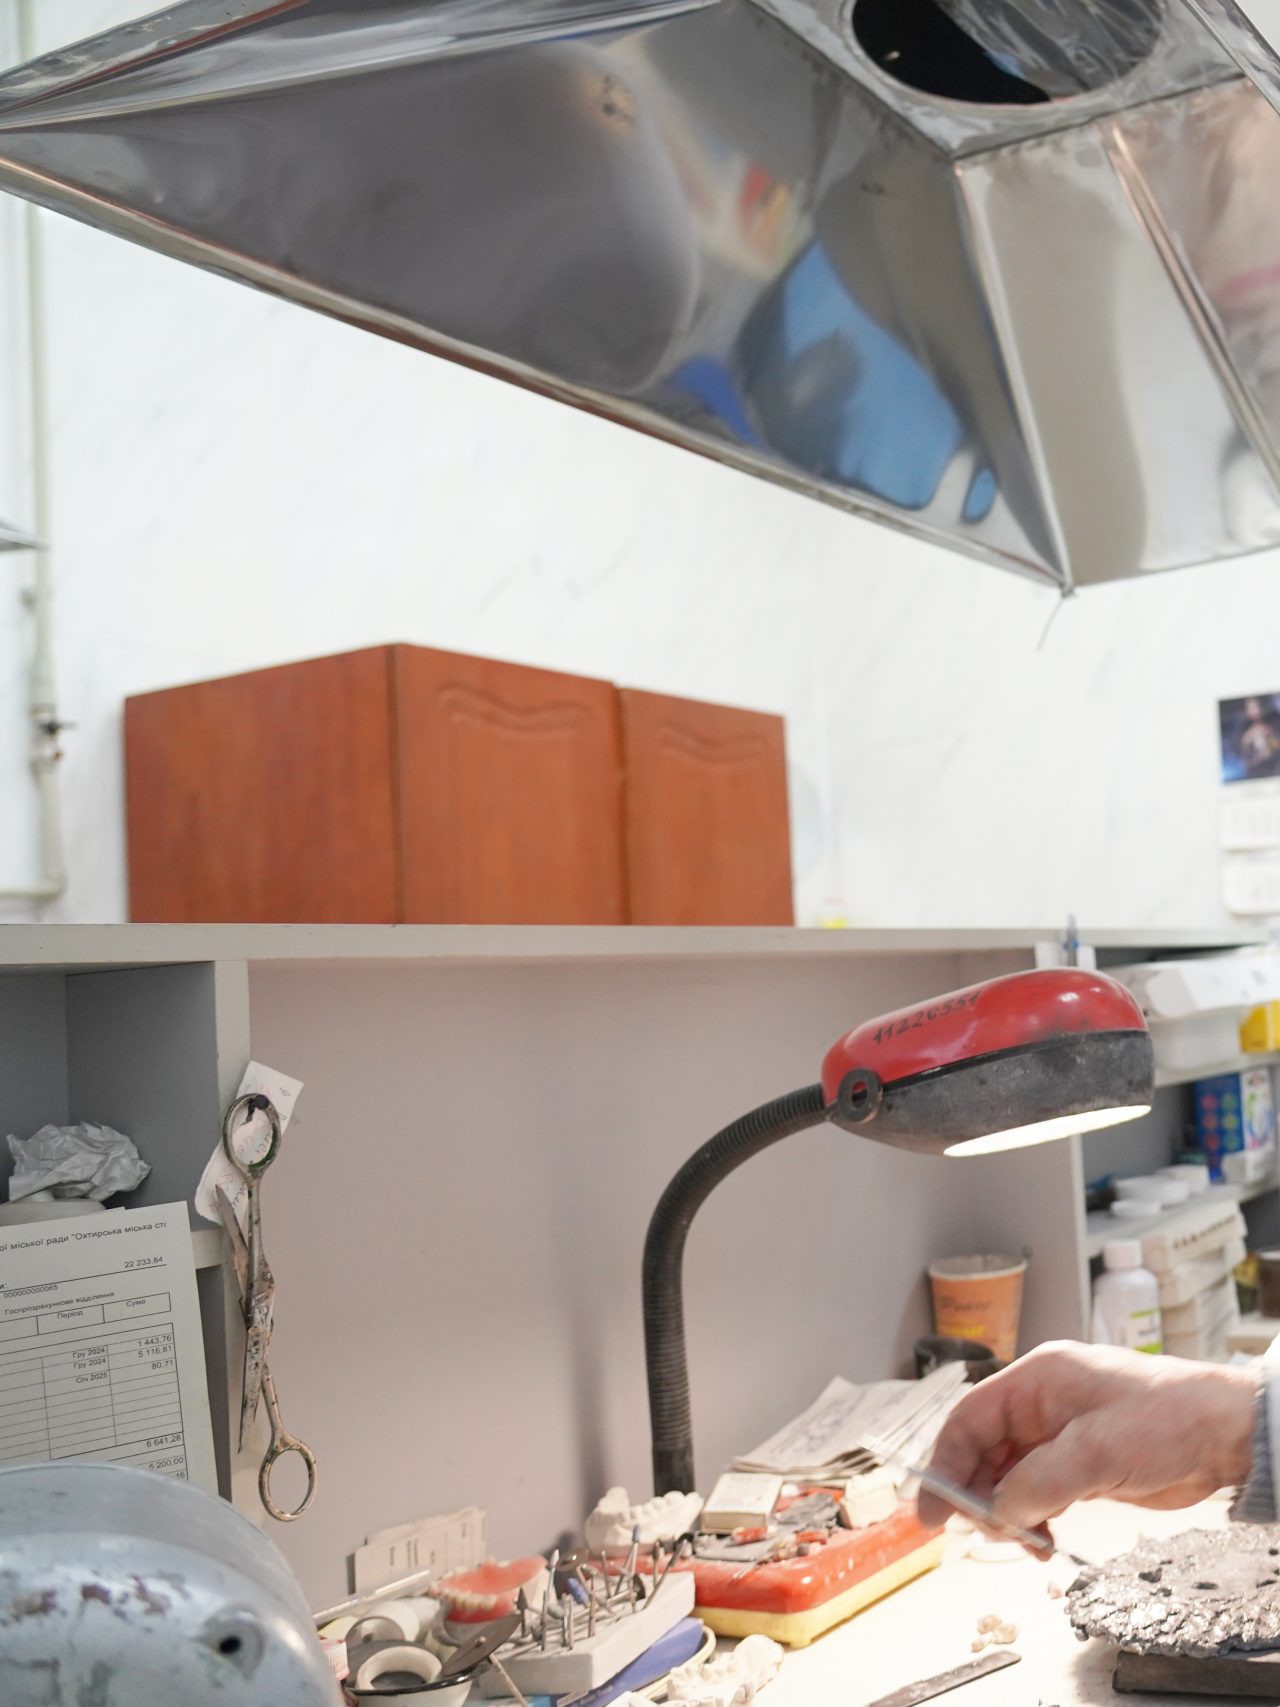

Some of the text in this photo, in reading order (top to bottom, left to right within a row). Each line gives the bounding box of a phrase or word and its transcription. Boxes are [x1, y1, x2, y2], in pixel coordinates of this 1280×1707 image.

[10, 1240, 44, 1250] міської
[46, 1236, 69, 1246] ради
[124, 1223, 153, 1233] міська
[126, 1299, 146, 1307] Сума
[57, 1310, 83, 1319] Період
[87, 1348, 106, 1356] 2024
[88, 1358, 106, 1367] 2024
[90, 1373, 108, 1381] 2025
